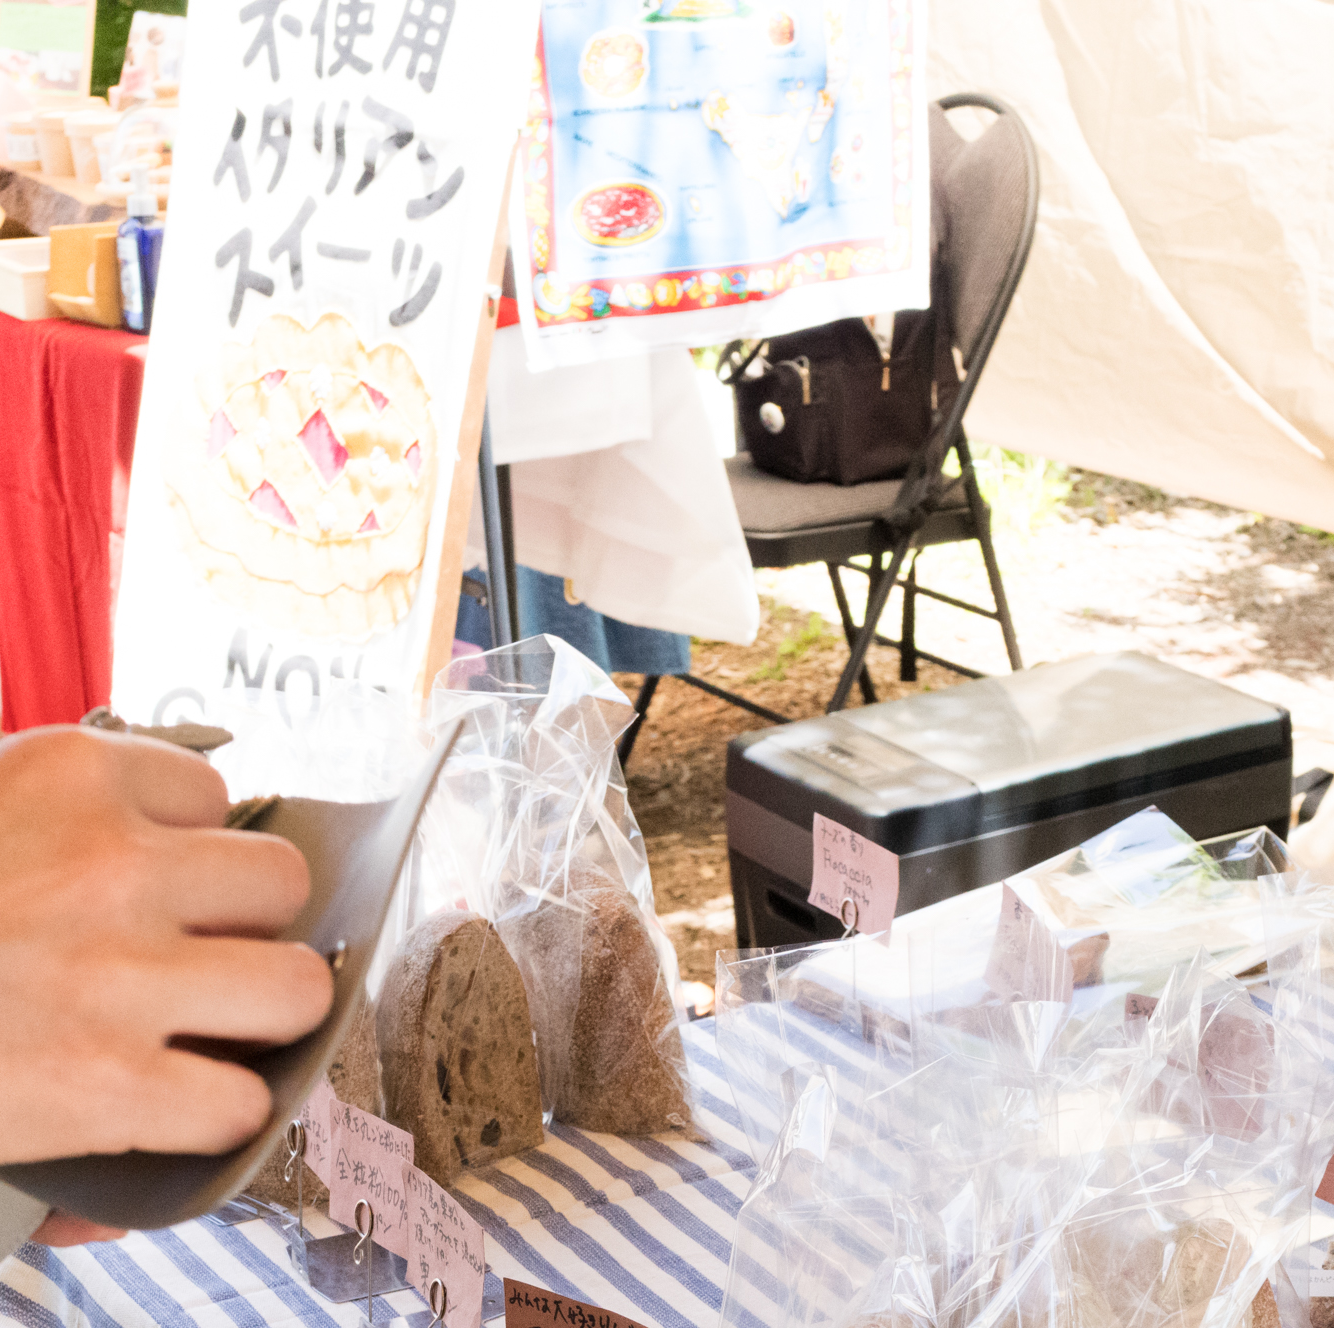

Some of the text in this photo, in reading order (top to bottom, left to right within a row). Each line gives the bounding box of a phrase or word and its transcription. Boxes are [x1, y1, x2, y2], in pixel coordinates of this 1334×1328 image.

[239, 0, 456, 94] 不使用
[213, 95, 465, 221] イタリアン
[214, 195, 443, 329] スイーツ
